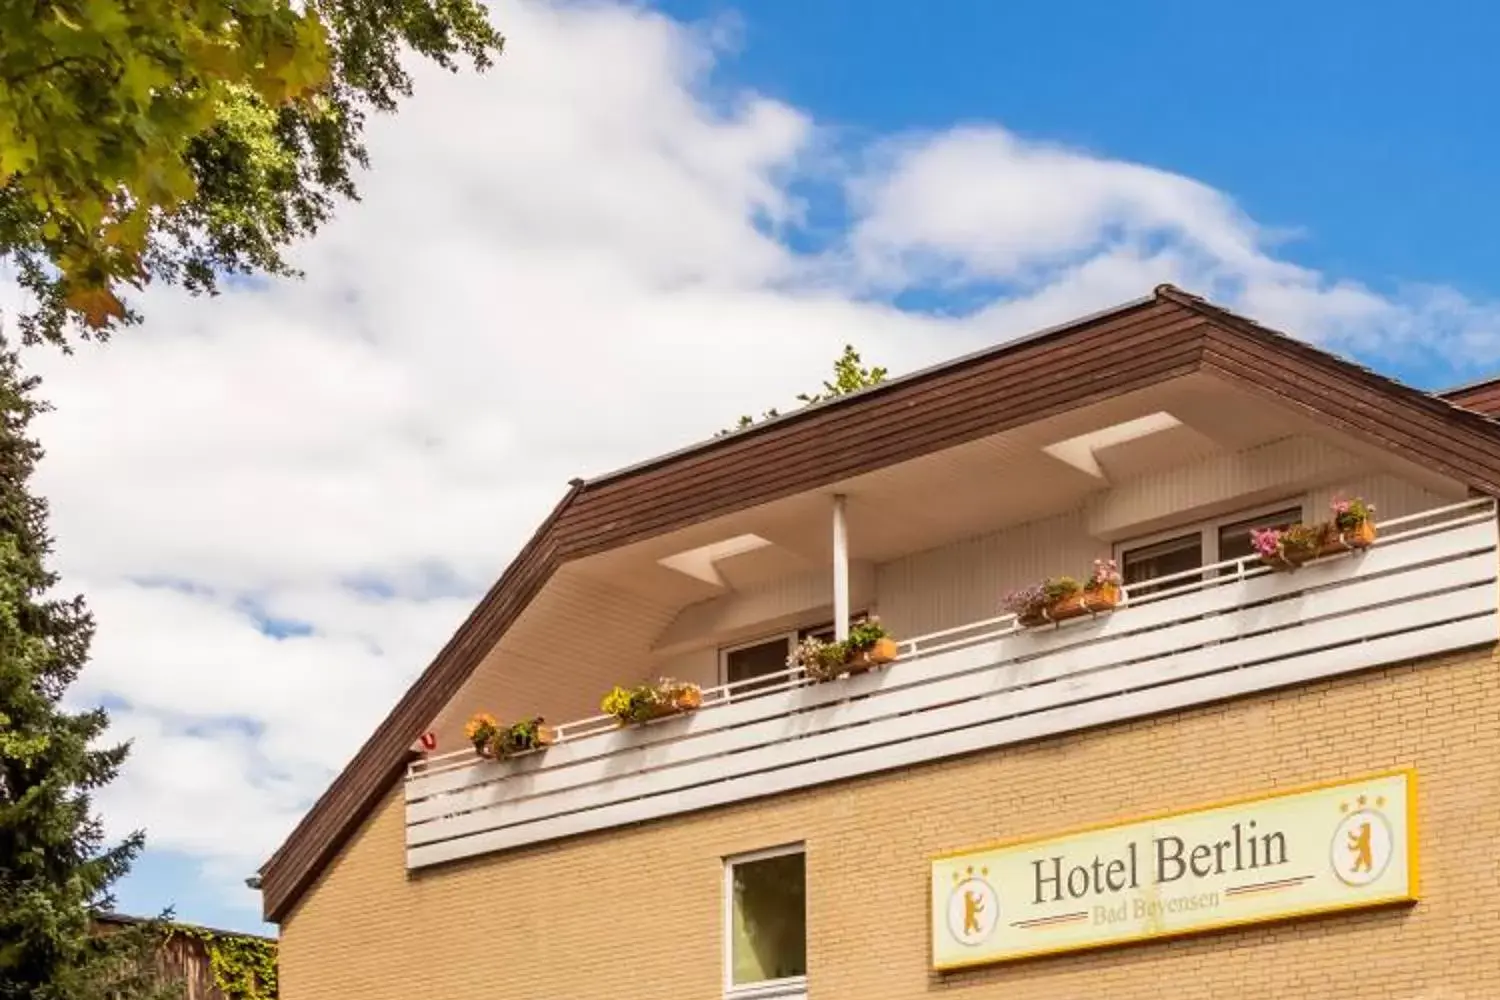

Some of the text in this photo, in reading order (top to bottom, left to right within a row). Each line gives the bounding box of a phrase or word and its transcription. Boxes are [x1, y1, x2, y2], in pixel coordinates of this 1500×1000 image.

[1032, 820, 1289, 904] Hotel Berlin
[1092, 899, 1129, 926] Bad
